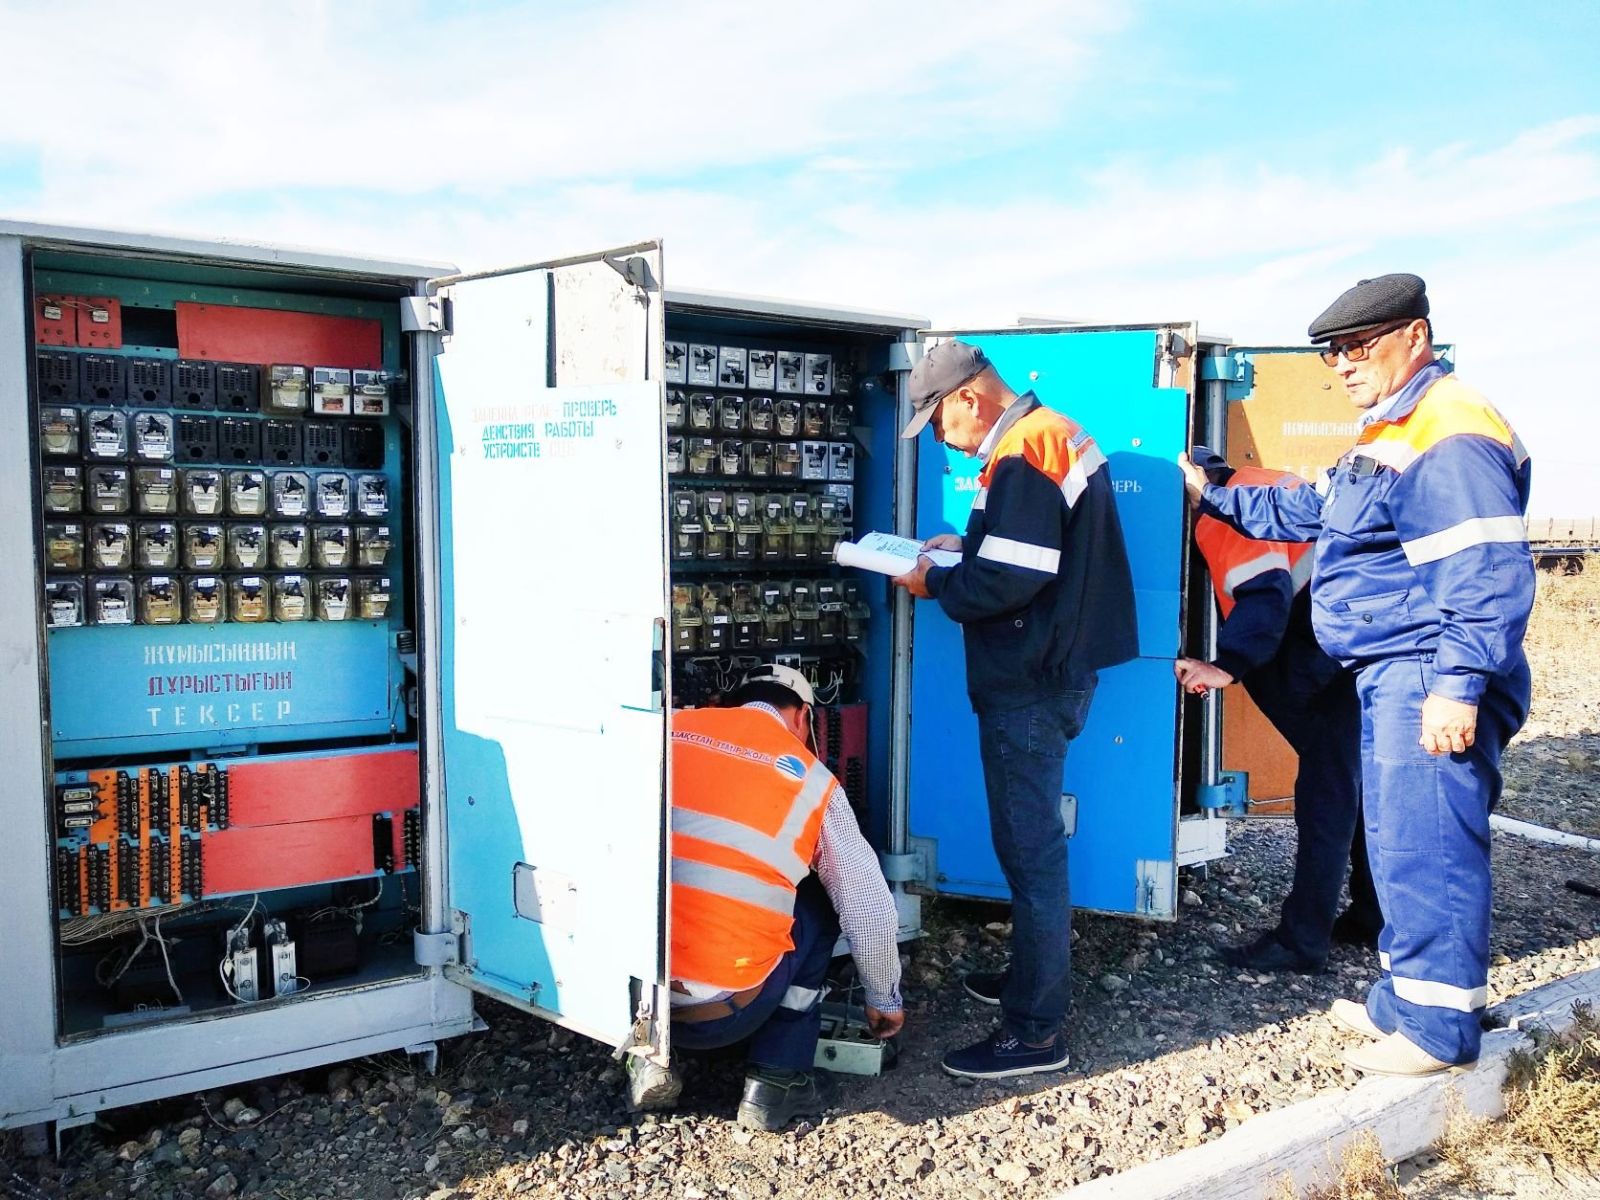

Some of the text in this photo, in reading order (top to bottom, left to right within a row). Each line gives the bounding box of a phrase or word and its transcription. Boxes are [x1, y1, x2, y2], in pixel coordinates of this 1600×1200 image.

[563, 400, 617, 417] ПРОВЕРЬ
[545, 420, 594, 437] РАБОТЫ
[146, 701, 291, 727] ТЕКСЕР
